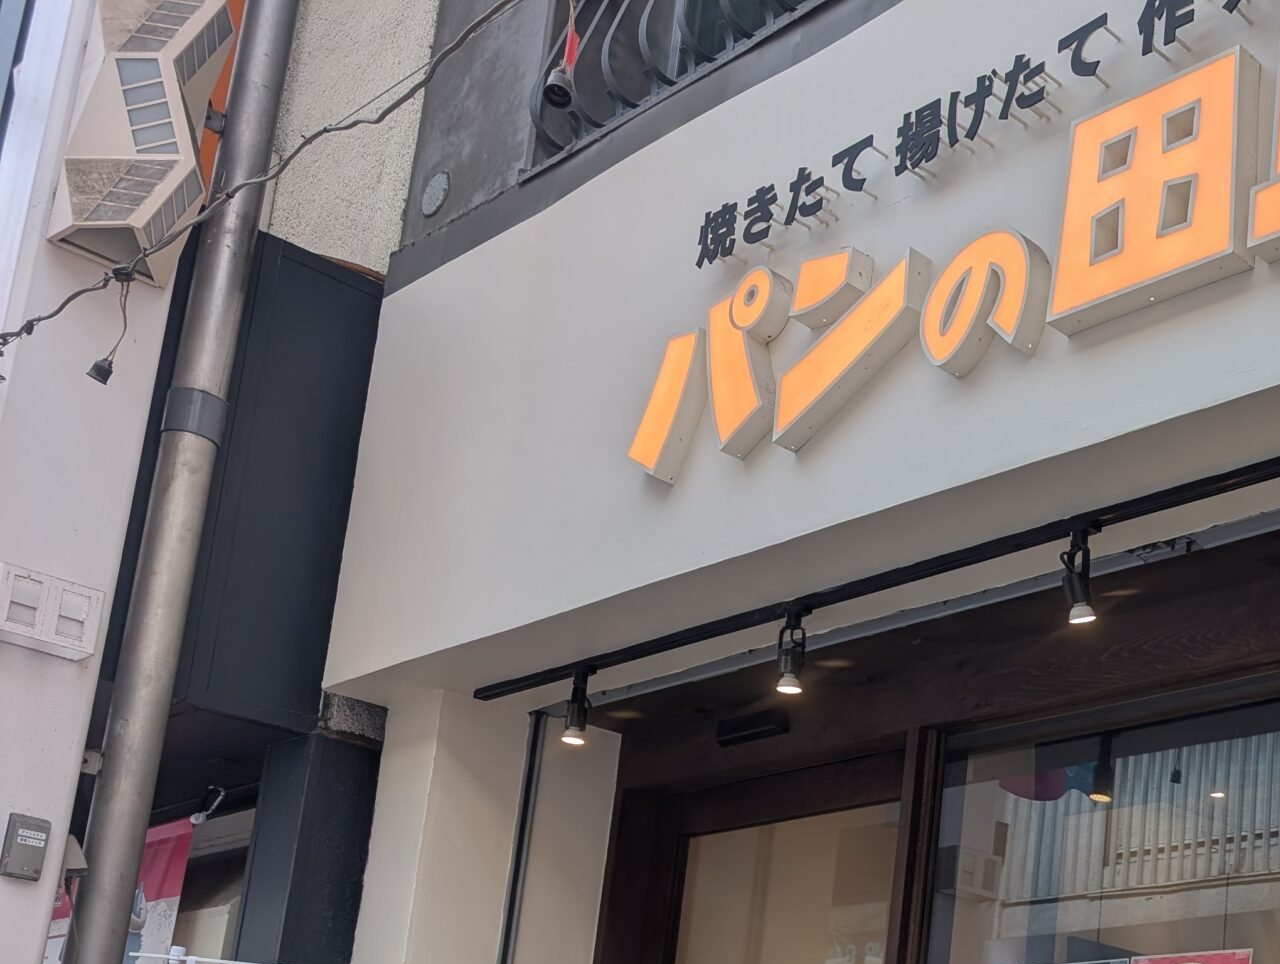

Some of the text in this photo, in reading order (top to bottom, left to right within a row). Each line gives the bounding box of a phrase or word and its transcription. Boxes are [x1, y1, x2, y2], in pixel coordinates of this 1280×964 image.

[695, 0, 1241, 269] 焼きたて 揚げたて 作
